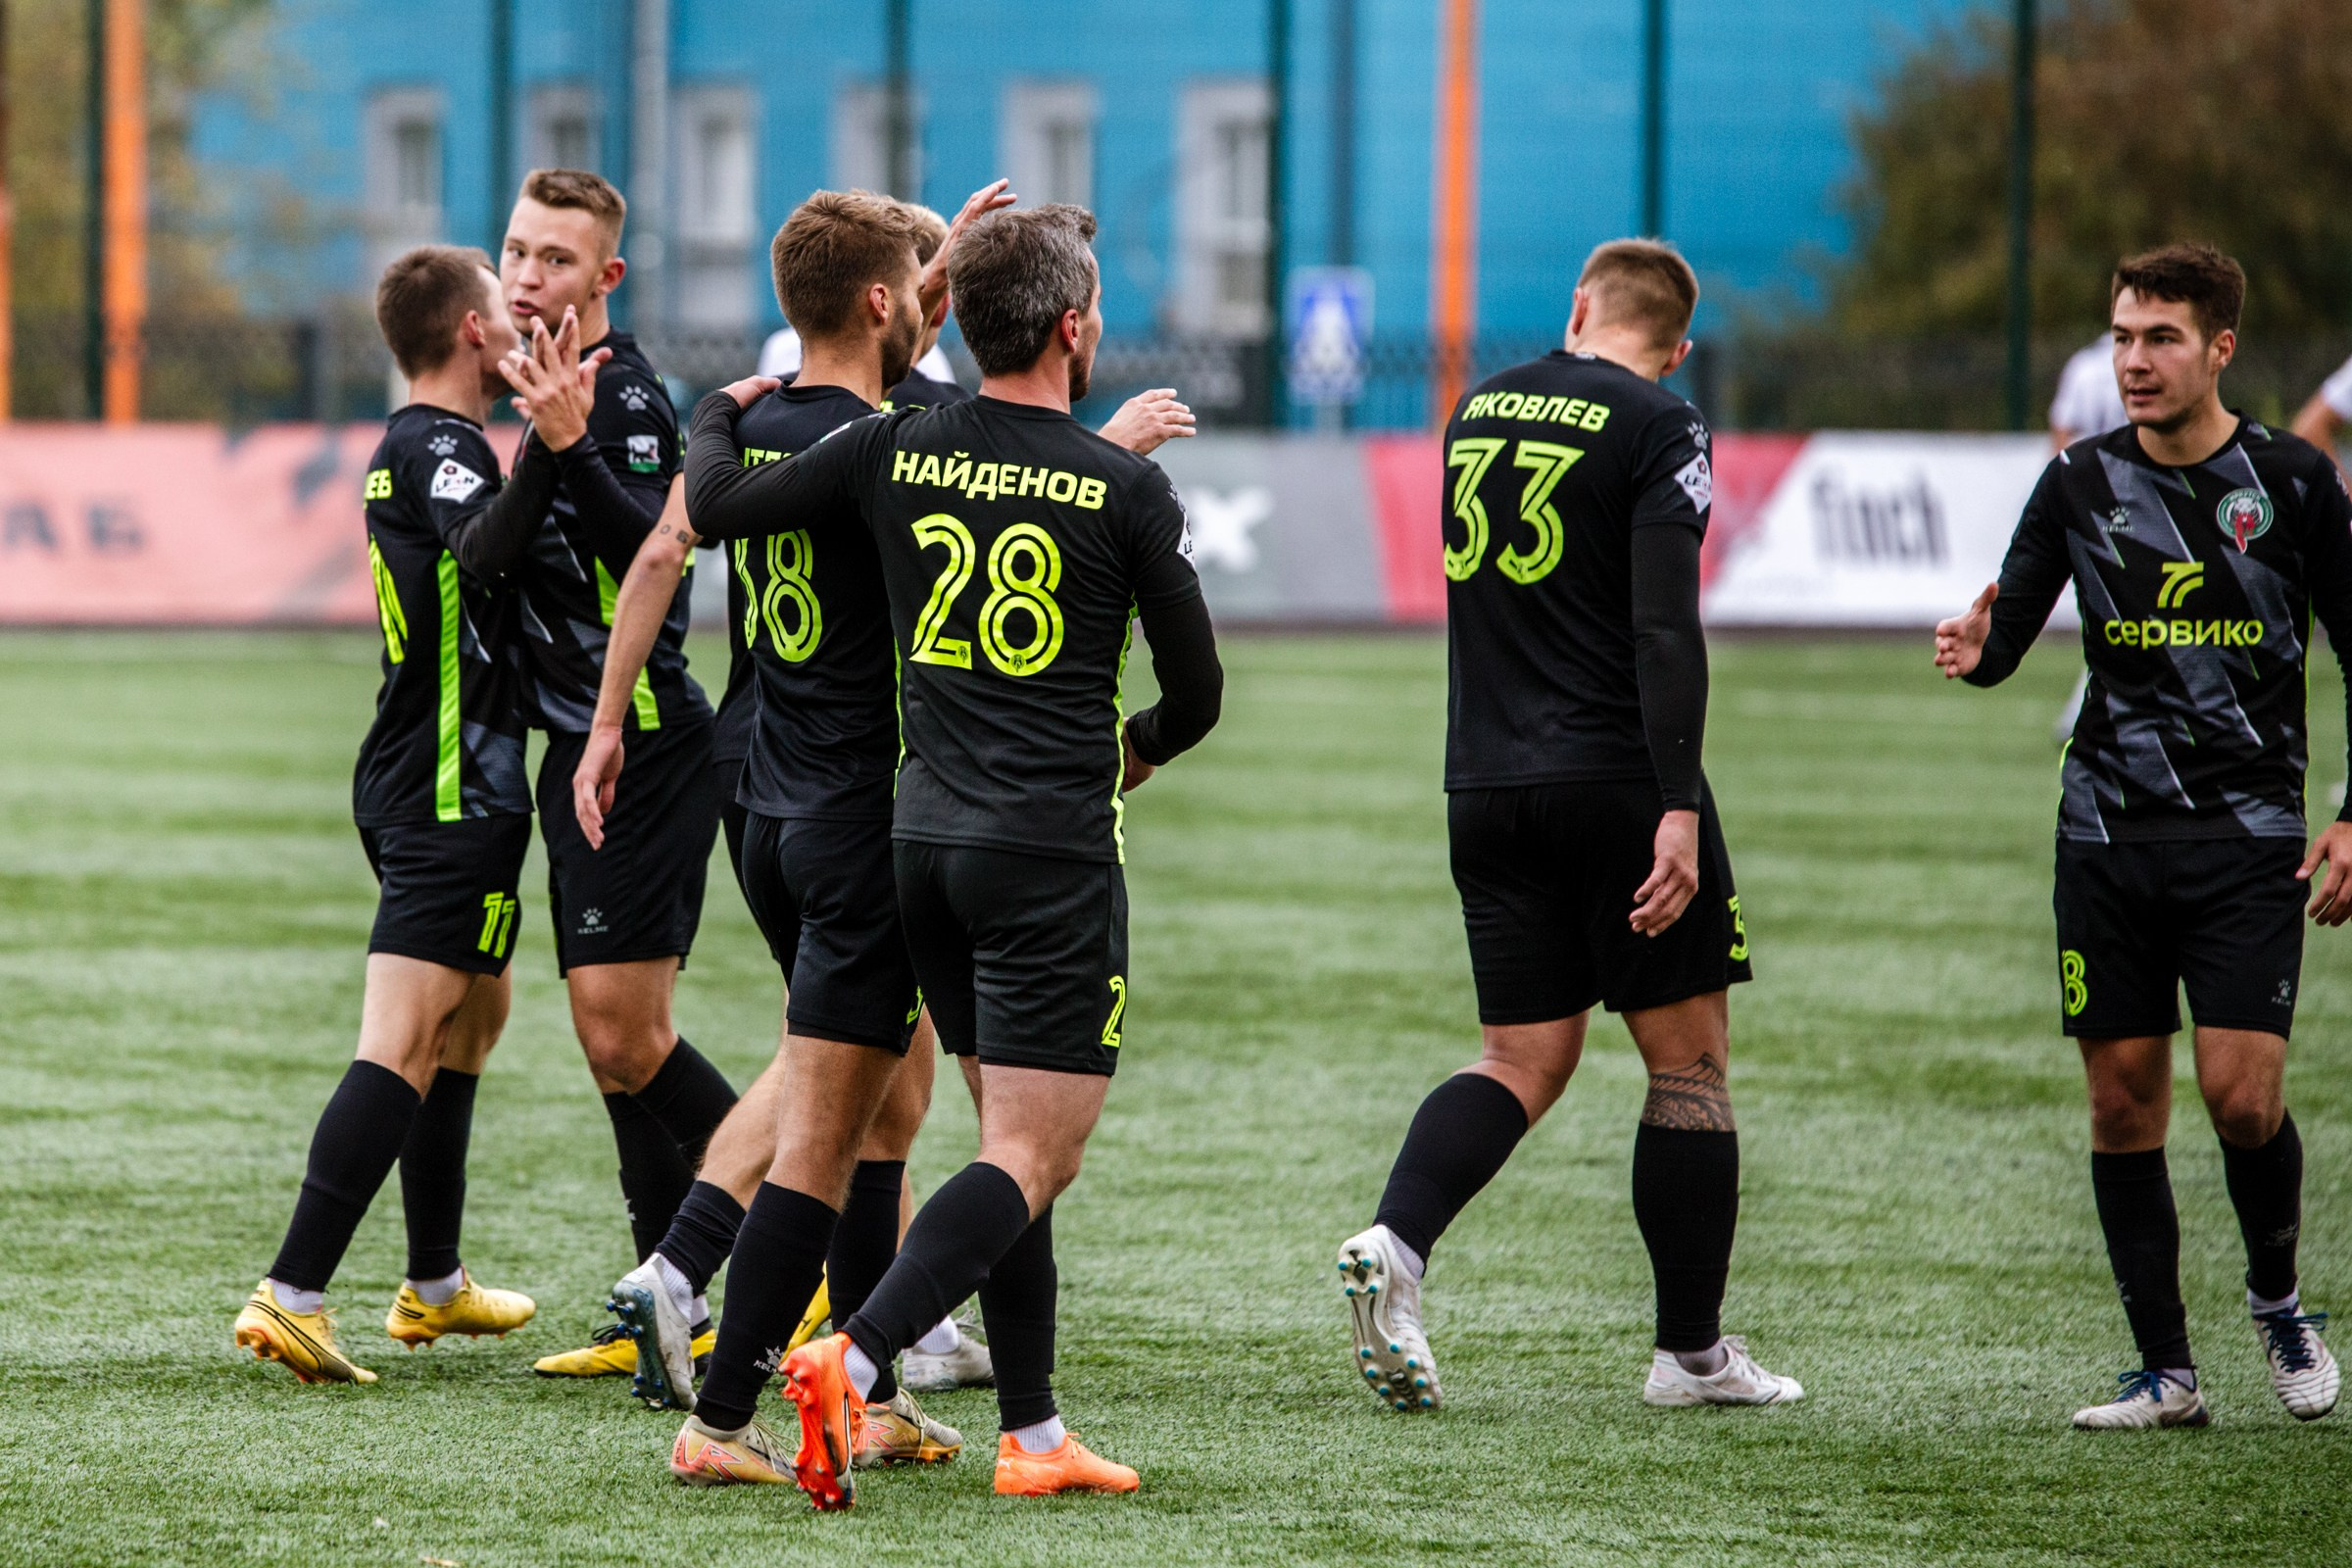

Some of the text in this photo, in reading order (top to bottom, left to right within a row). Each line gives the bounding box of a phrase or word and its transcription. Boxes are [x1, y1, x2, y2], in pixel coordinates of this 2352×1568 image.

[1461, 391, 1610, 433] ЯКОВЛЕВ
[892, 450, 1107, 511] НАЙДЕНОВ
[1444, 437, 1585, 585] 33
[908, 513, 1065, 677] 28
[2104, 618, 2265, 650] сервико
[477, 891, 516, 959] 11
